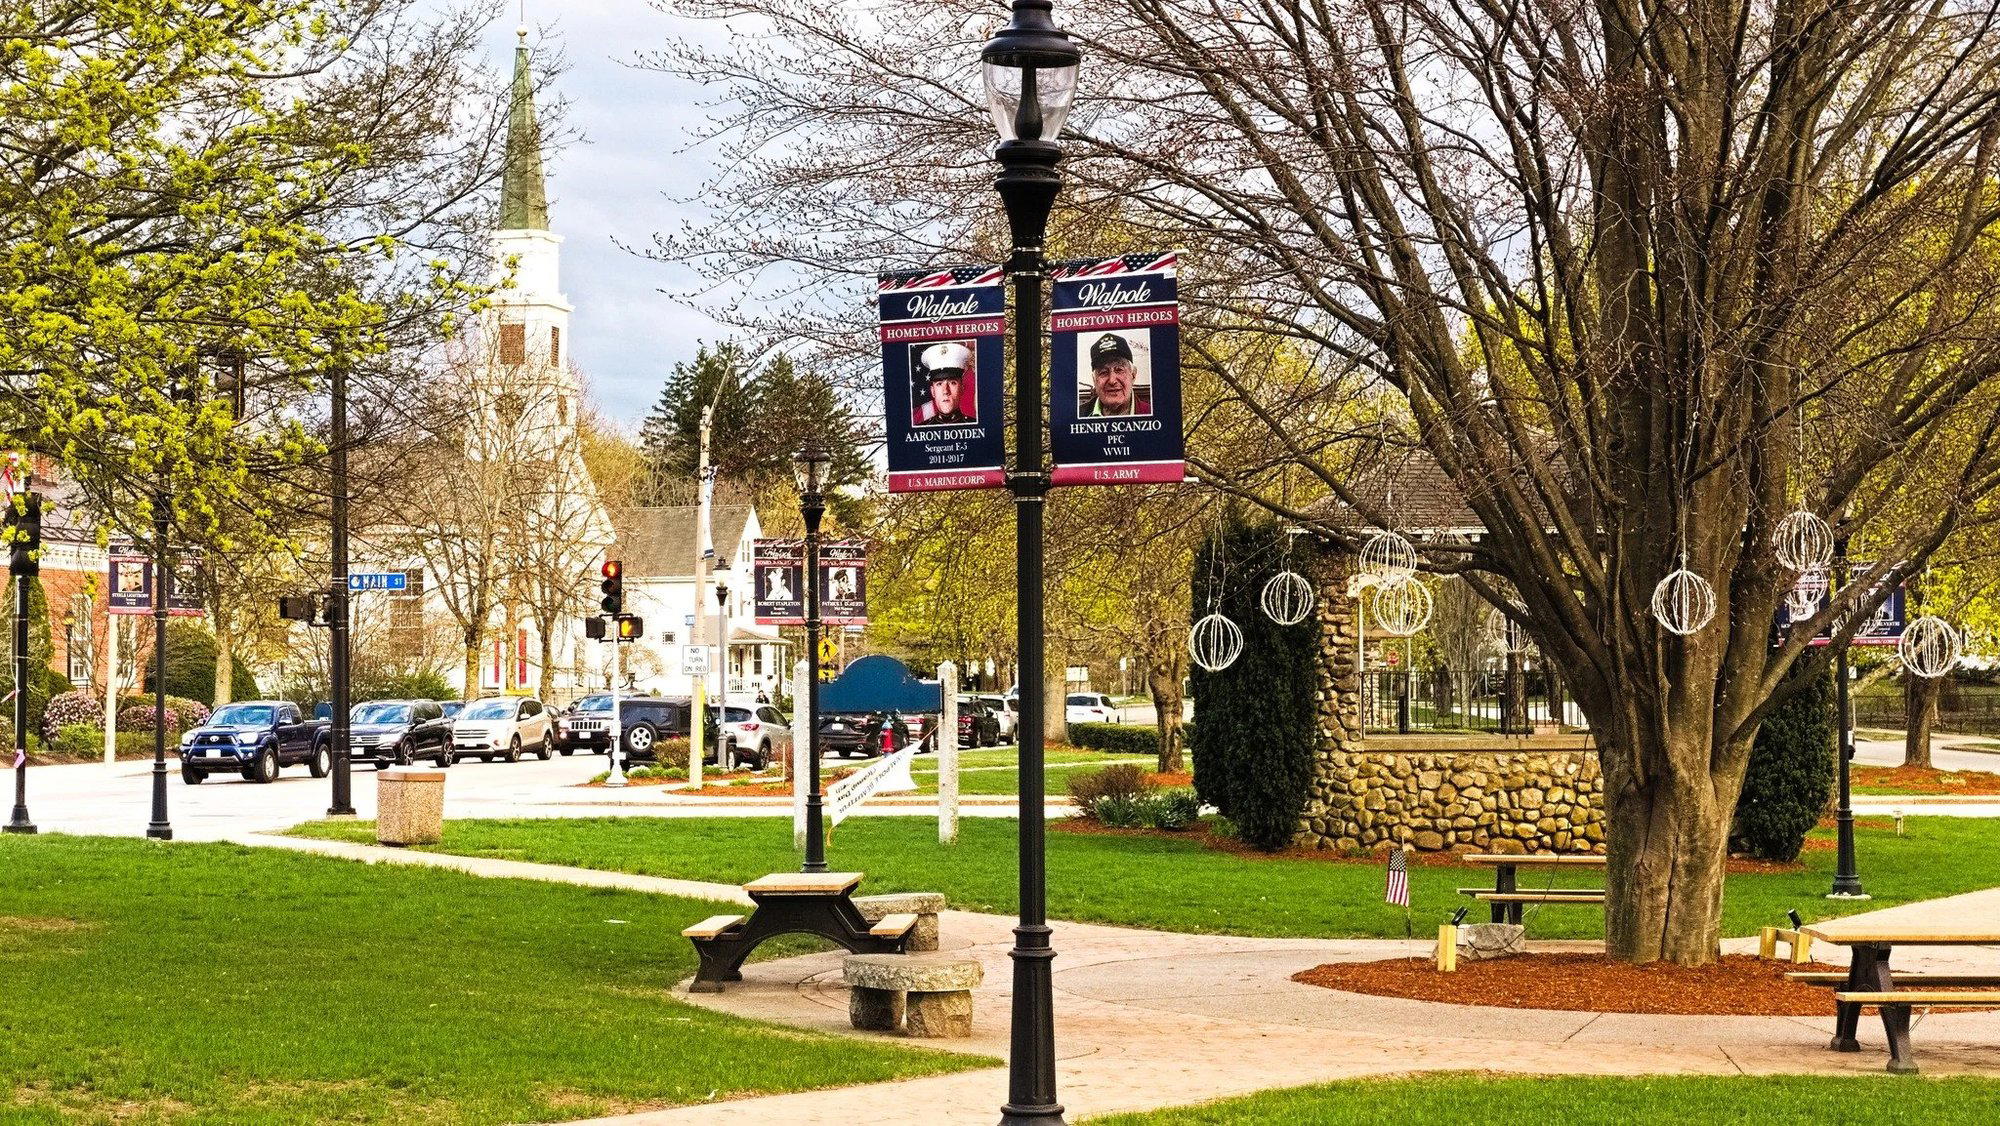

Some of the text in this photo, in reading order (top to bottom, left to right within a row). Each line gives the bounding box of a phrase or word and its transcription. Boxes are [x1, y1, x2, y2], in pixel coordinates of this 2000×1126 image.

[1078, 281, 1151, 312] Walpole
[907, 294, 978, 323] Walpole
[1056, 311, 1172, 329] HOMETOWN HEROES
[887, 322, 999, 339] HOMETOWN HEROES
[1070, 420, 1162, 434] HENRY SCANZIO
[906, 428, 985, 442] AARON BOYDEN
[1107, 435, 1125, 444] PFC
[925, 444, 953, 453] Sergeant
[1103, 446, 1130, 456] WWII
[928, 454, 965, 464] 2011-2017
[1094, 468, 1141, 480] U.S. ARMY
[908, 475, 985, 486] U.S. MARINE CORPS
[363, 576, 403, 588] MAIN ST
